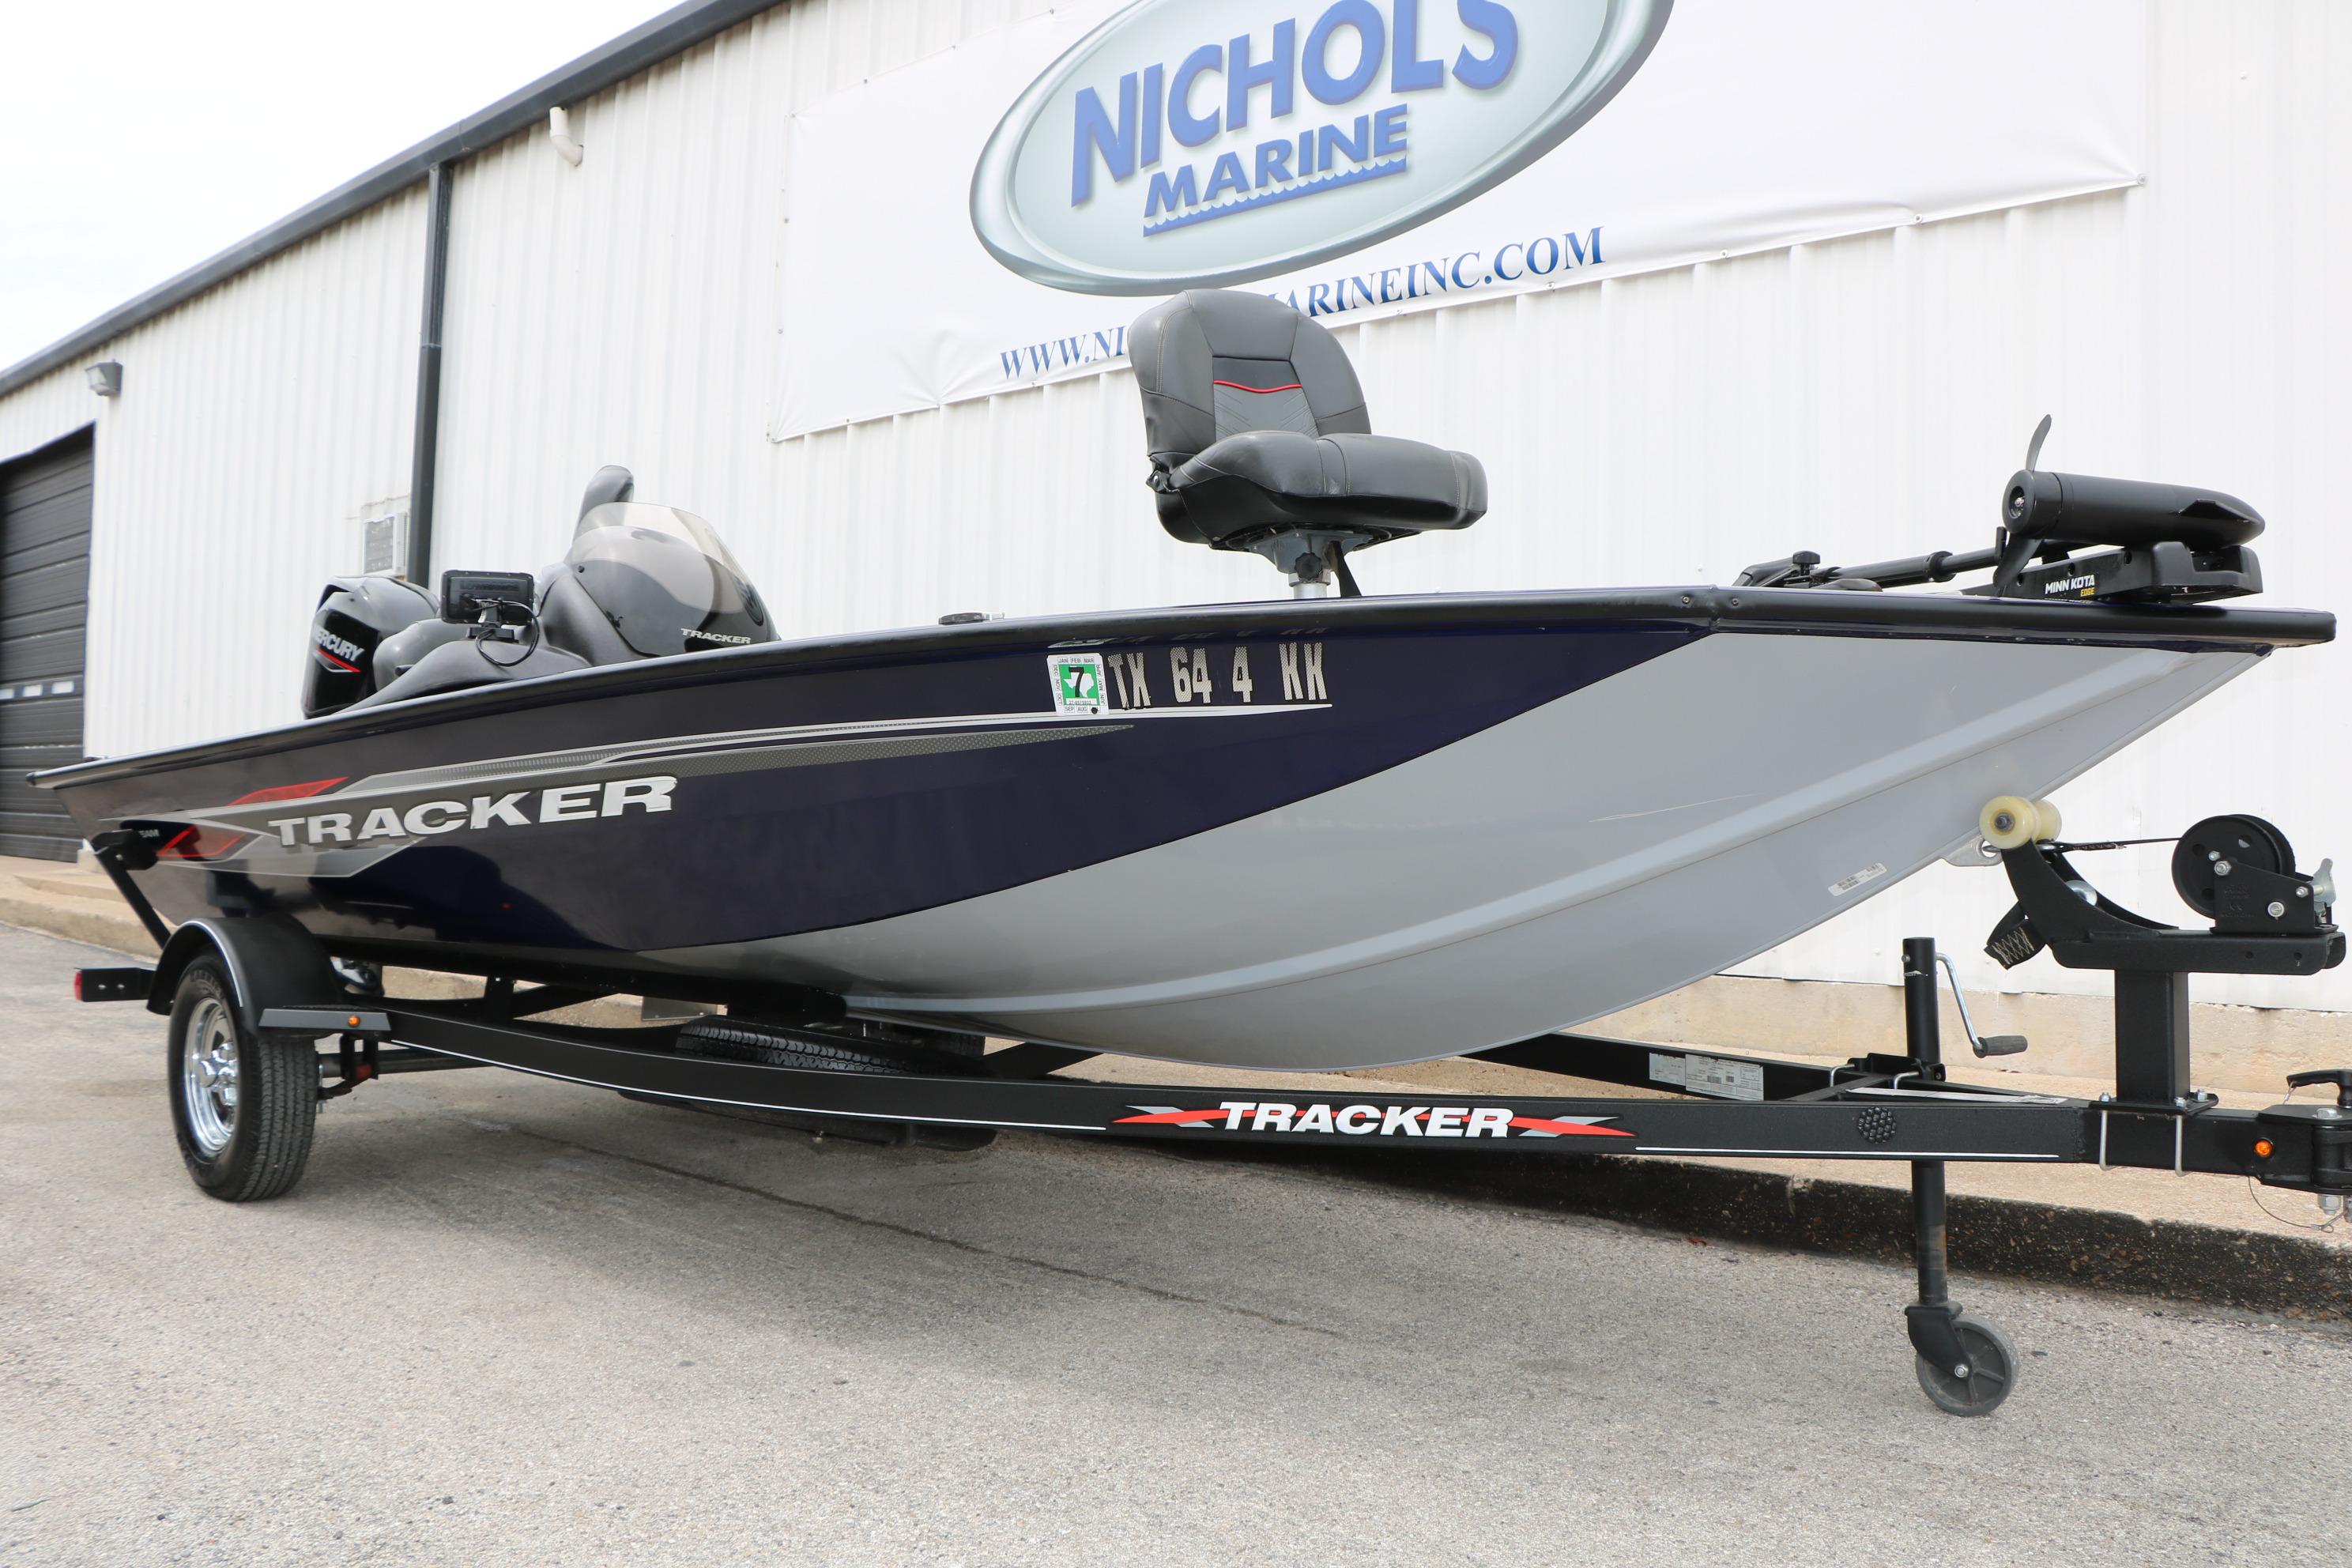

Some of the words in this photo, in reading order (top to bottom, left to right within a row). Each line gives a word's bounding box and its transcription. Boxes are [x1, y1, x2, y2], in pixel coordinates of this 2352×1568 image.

[1071, 0, 1518, 208] NICHOLS
[1144, 103, 1408, 218] MARINE
[999, 225, 1607, 380] WWW.NIARINEINC.COM
[2045, 579, 2070, 594] MINN
[2071, 575, 2095, 590] KOTA
[680, 628, 752, 644] TRACKER
[1069, 666, 1084, 698] 7
[1108, 653, 1151, 710] TX
[1170, 646, 1212, 703] 64
[1232, 646, 1253, 703] 4
[1279, 642, 1328, 700] KK
[268, 775, 677, 846] TRACKER
[1219, 1101, 1514, 1138] TRACKER
